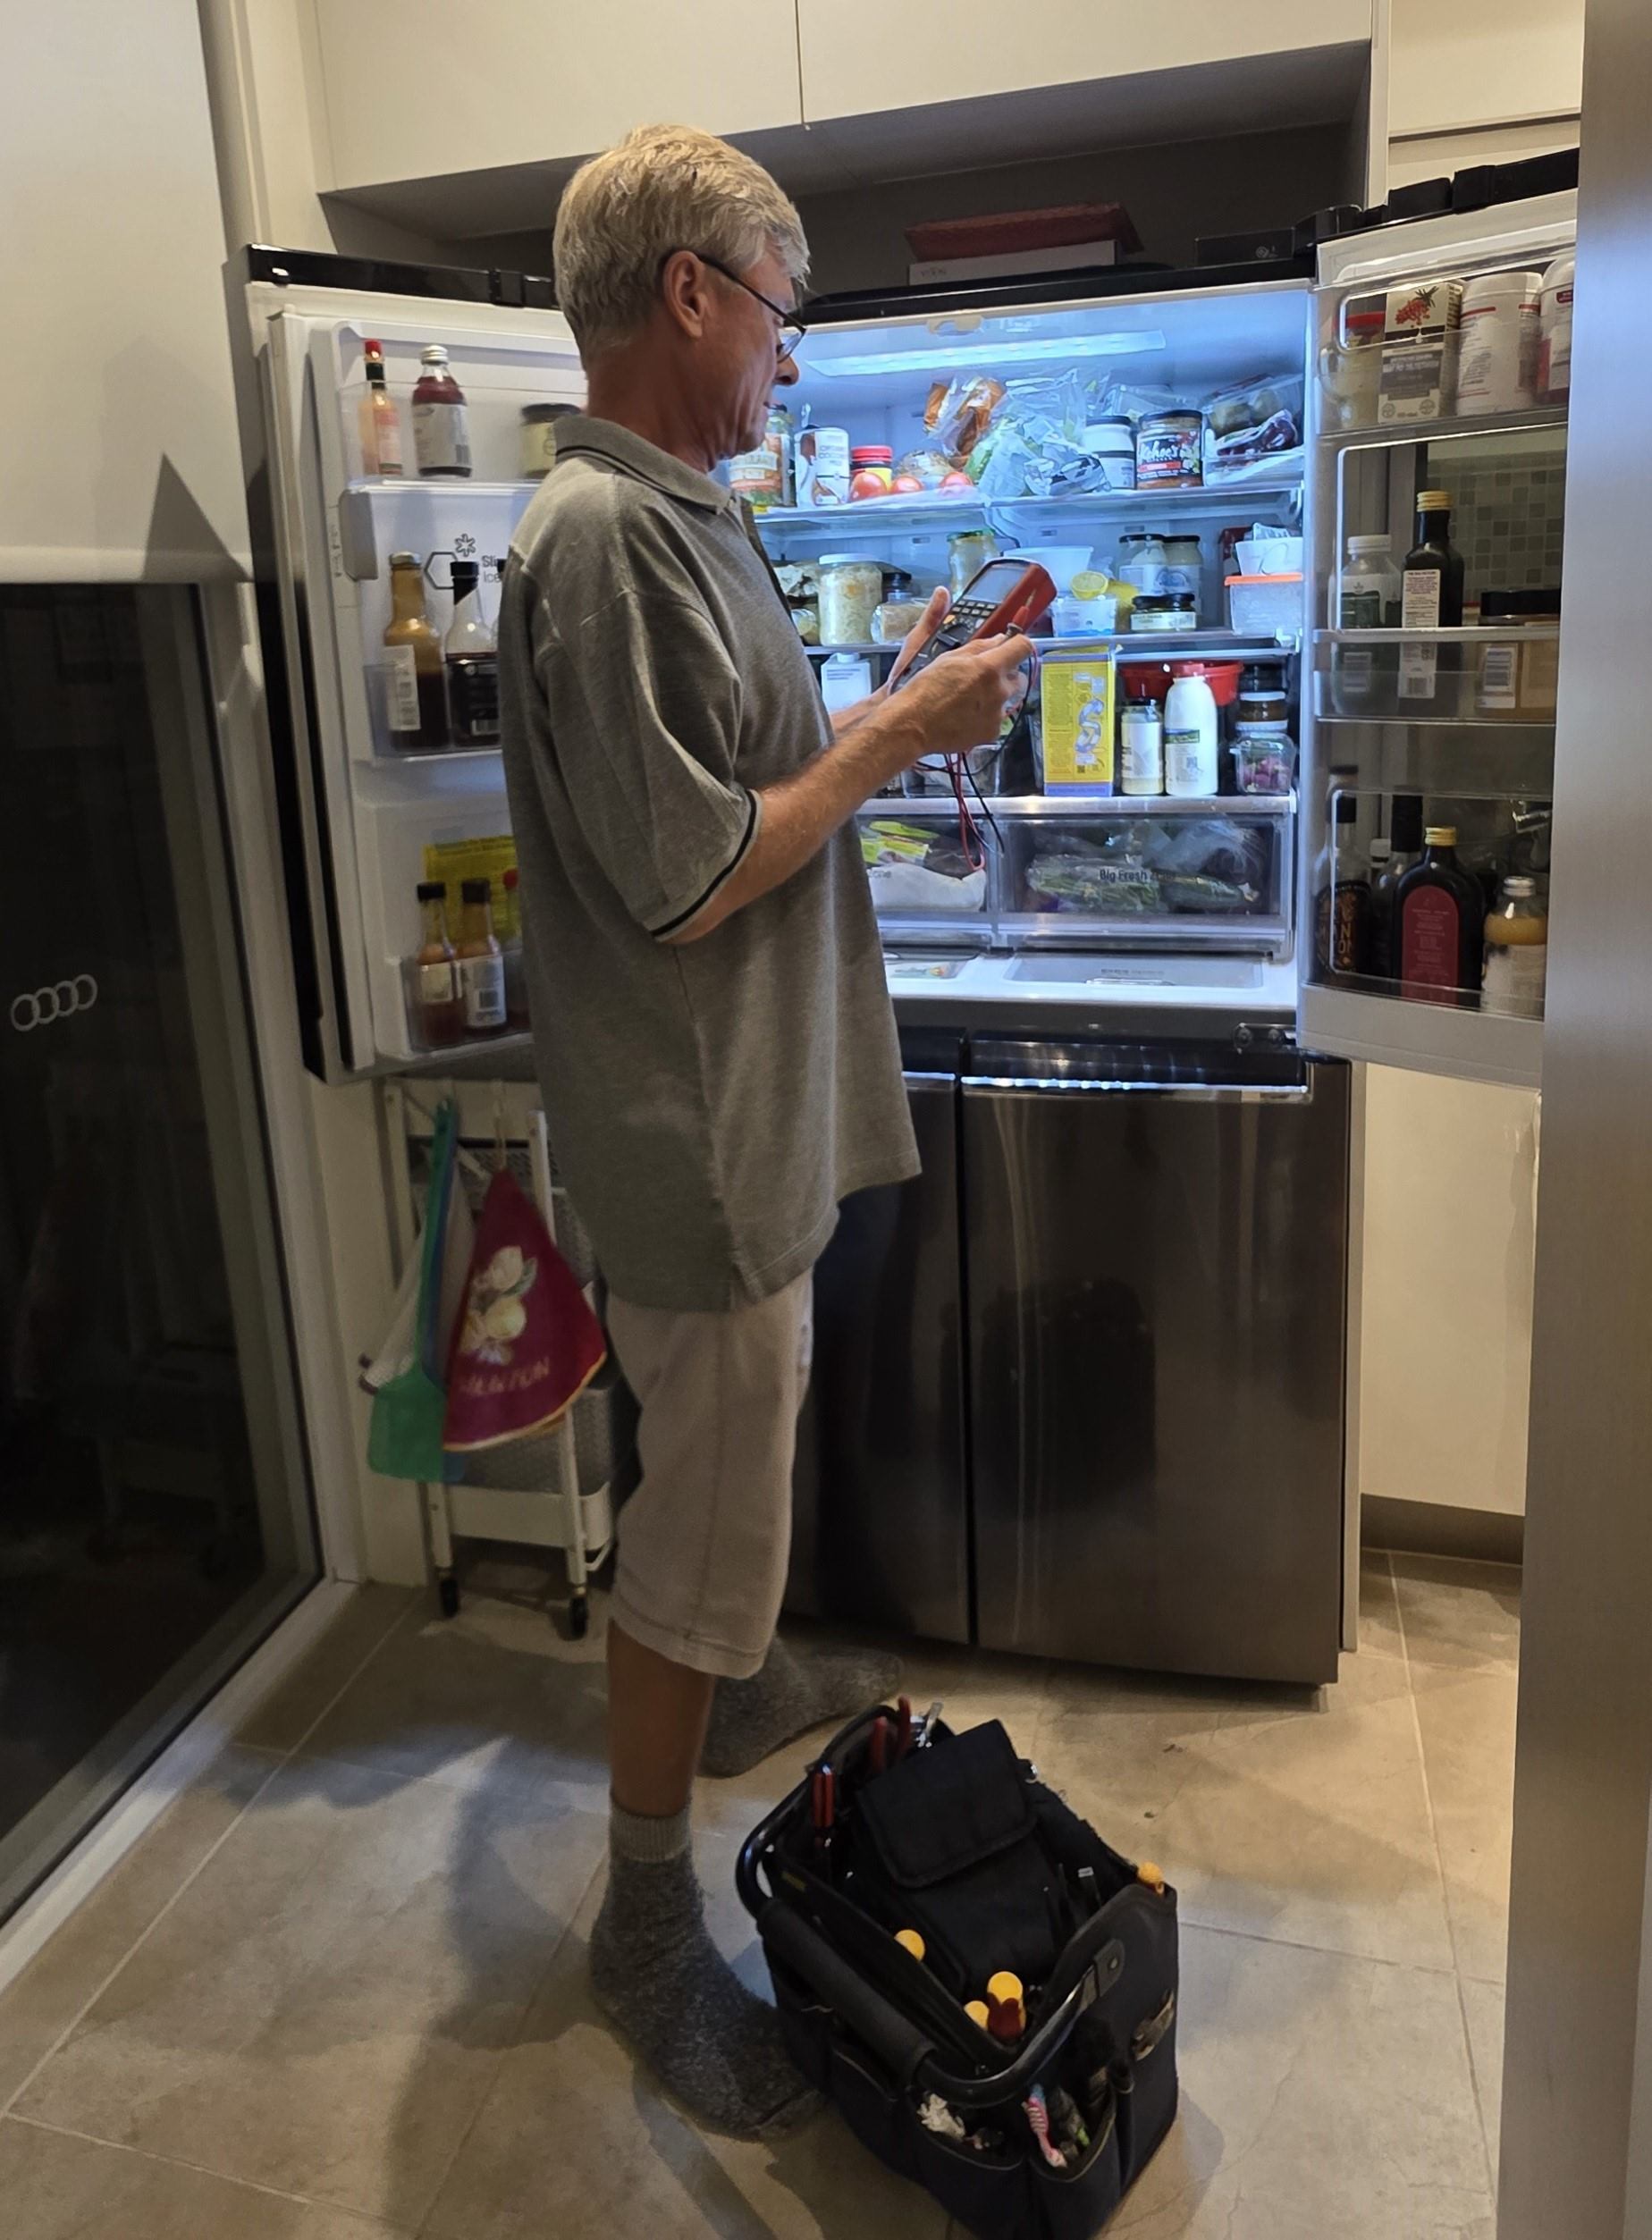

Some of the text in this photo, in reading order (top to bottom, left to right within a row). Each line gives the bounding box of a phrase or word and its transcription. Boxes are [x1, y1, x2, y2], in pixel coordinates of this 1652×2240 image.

[482, 555, 498, 568] Sli
[1100, 870, 1117, 883] Big
[1118, 871, 1148, 880] Fresh
